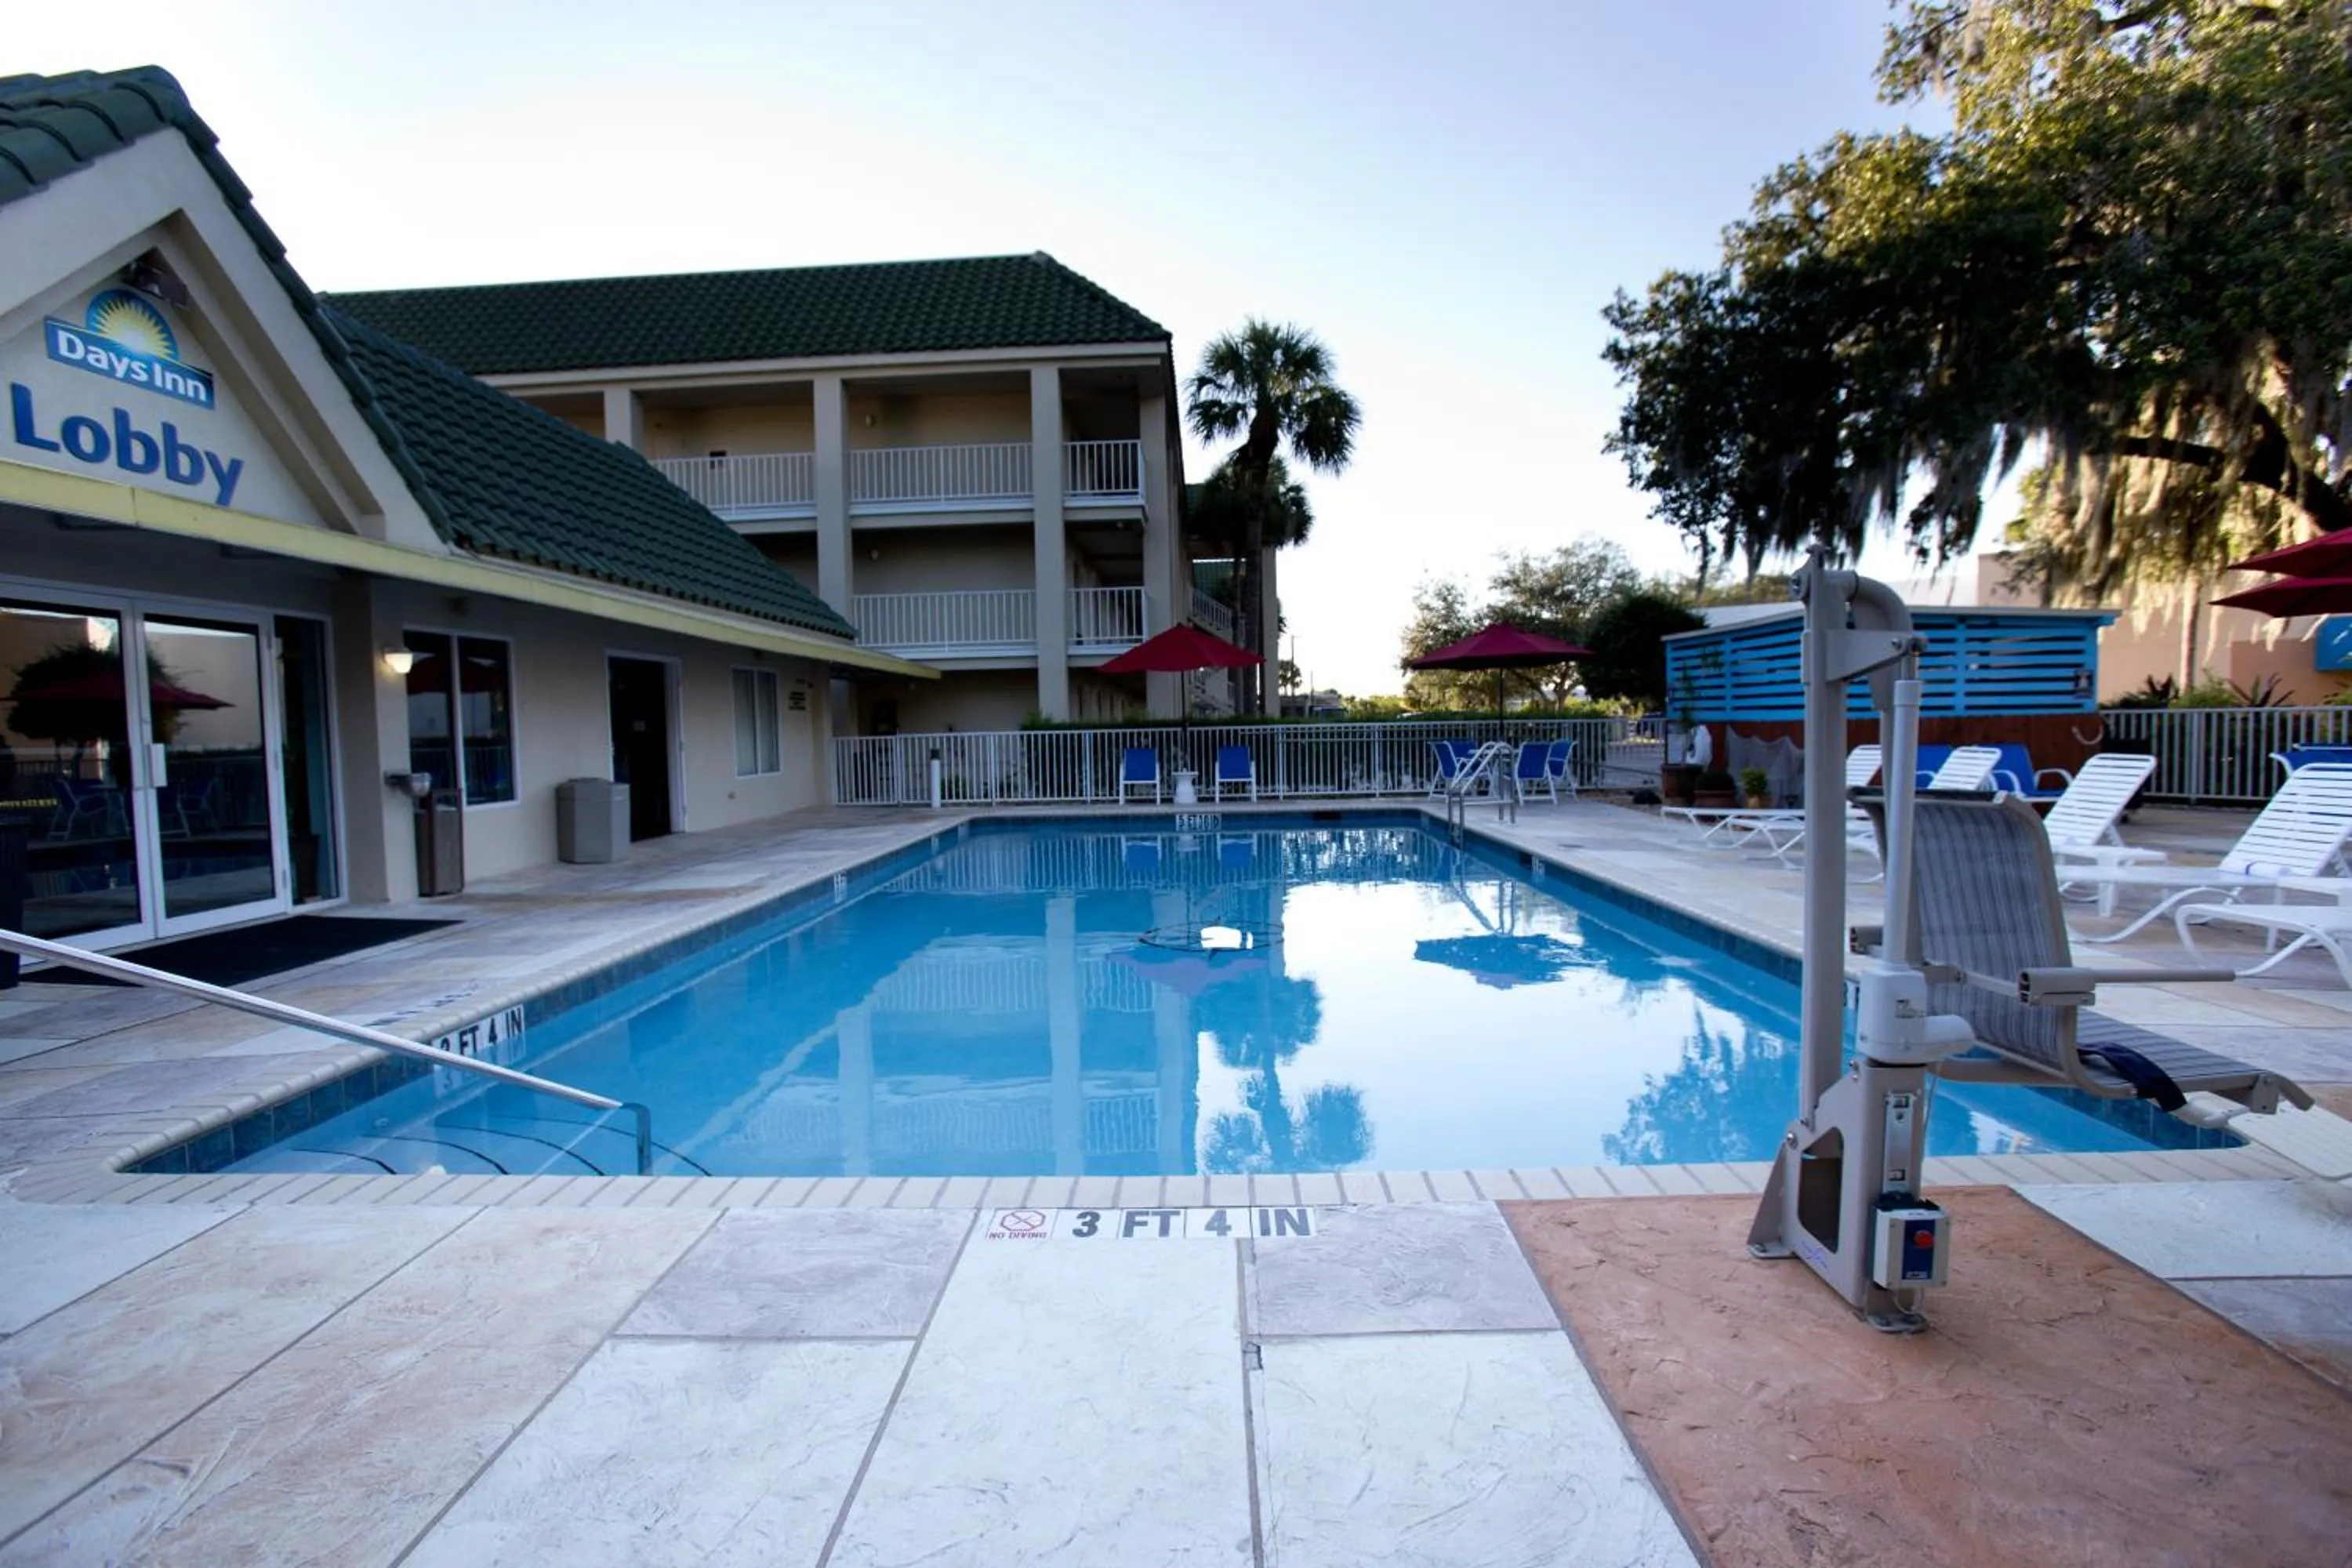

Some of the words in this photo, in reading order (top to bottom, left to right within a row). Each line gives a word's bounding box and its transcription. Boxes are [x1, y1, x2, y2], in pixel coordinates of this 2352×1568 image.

[57, 329, 149, 382] Days
[154, 362, 208, 401] Inn
[10, 382, 245, 506] Lobby
[459, 1025, 479, 1055] FT
[488, 1017, 497, 1044] 4
[506, 1007, 522, 1038] IN
[1072, 1210, 1102, 1238] 3
[1122, 1210, 1181, 1238] FT
[1204, 1209, 1232, 1236] 4
[1258, 1208, 1311, 1236] IN
